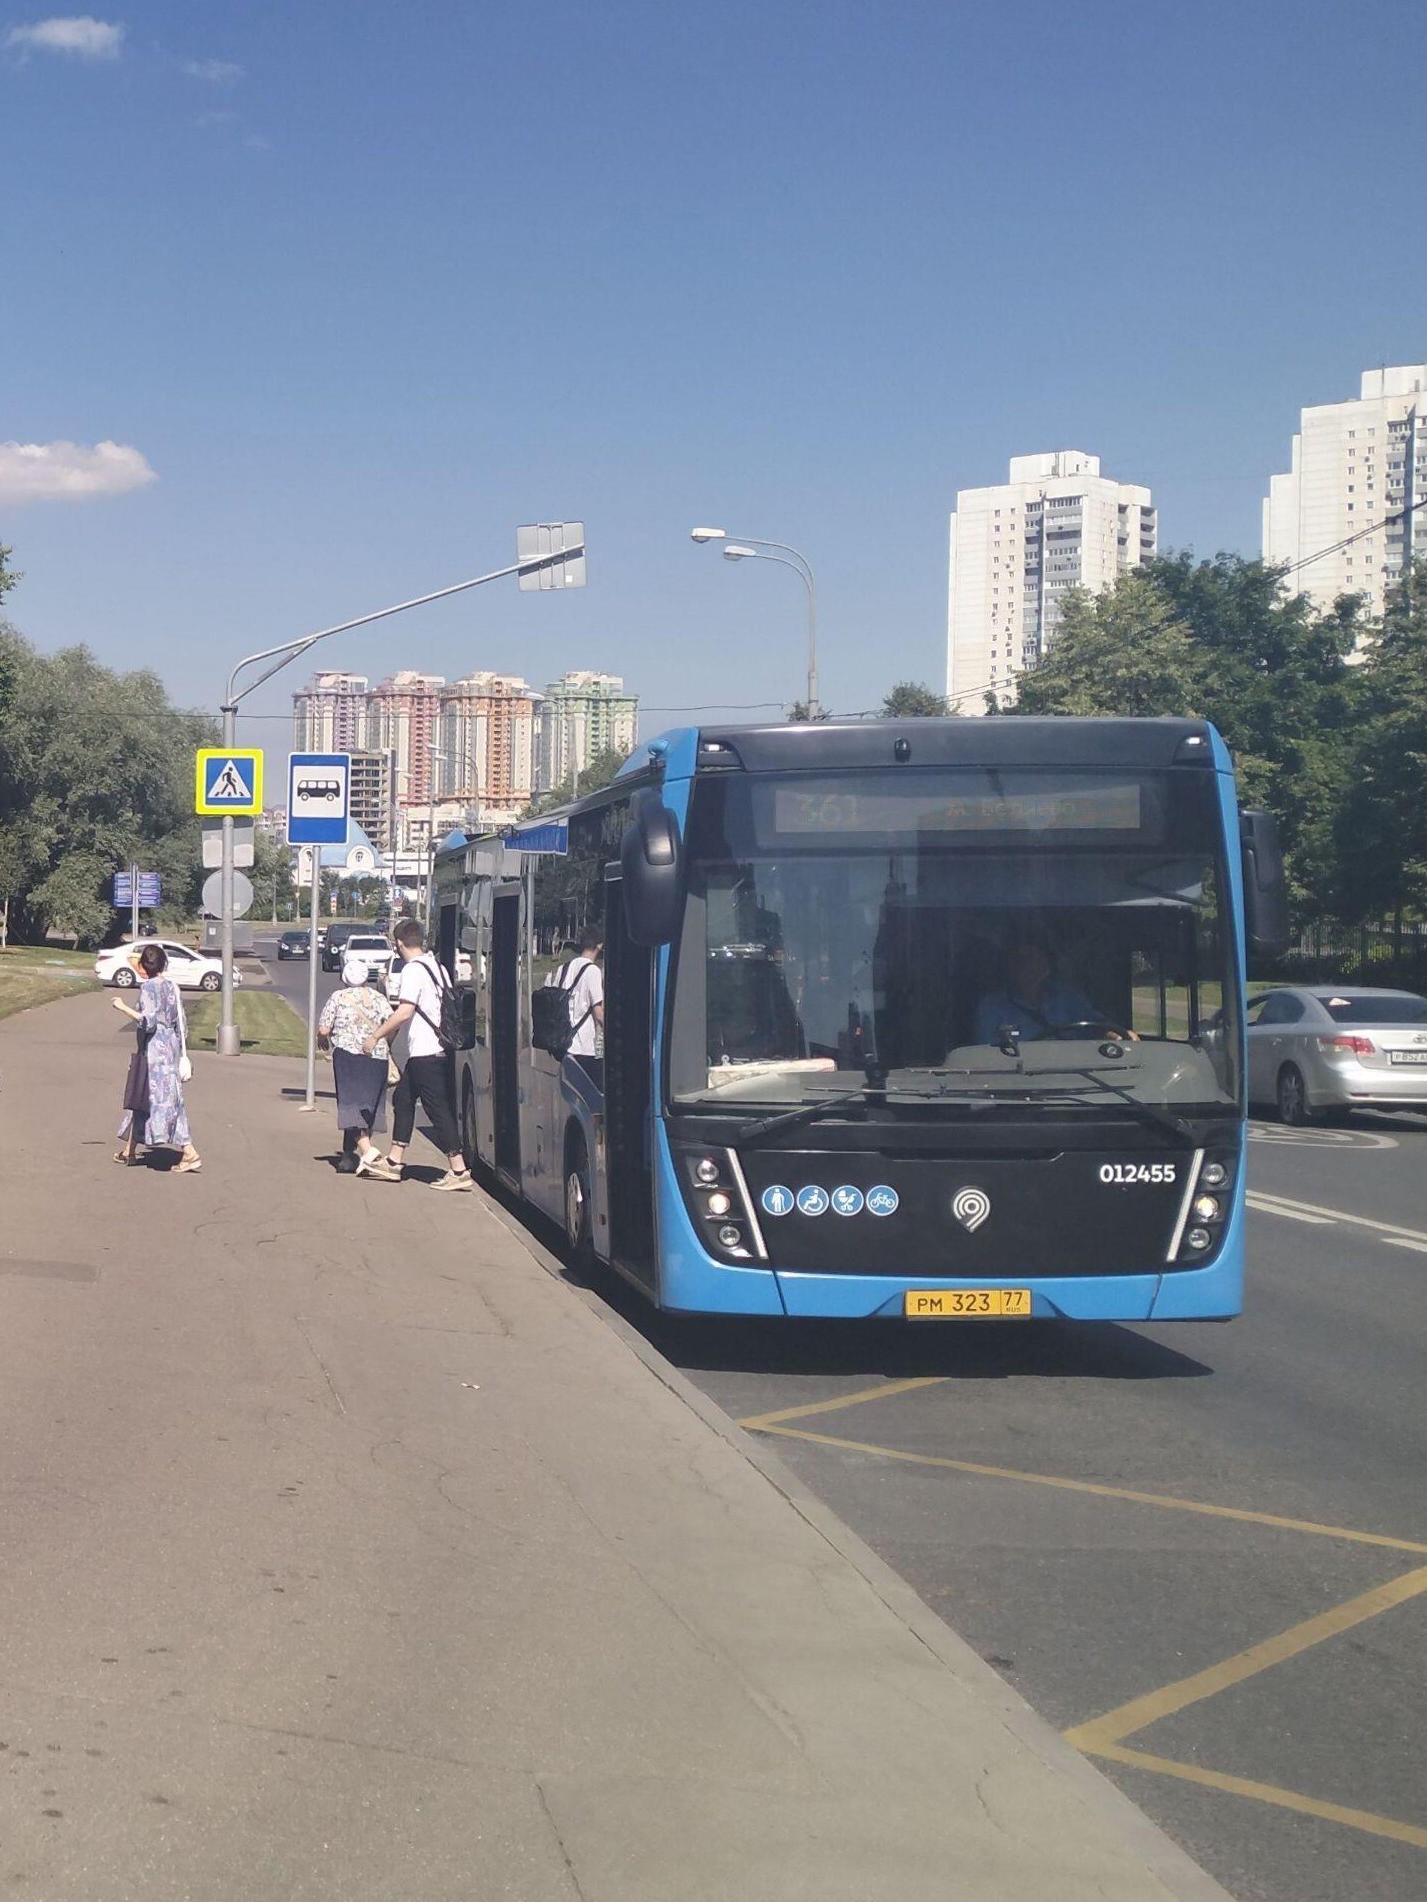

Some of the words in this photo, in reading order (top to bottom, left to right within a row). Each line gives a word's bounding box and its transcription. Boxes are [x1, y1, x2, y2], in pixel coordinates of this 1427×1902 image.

[1099, 1164, 1176, 1183] 012455
[952, 1293, 990, 1312] 323
[1004, 1292, 1023, 1307] 77
